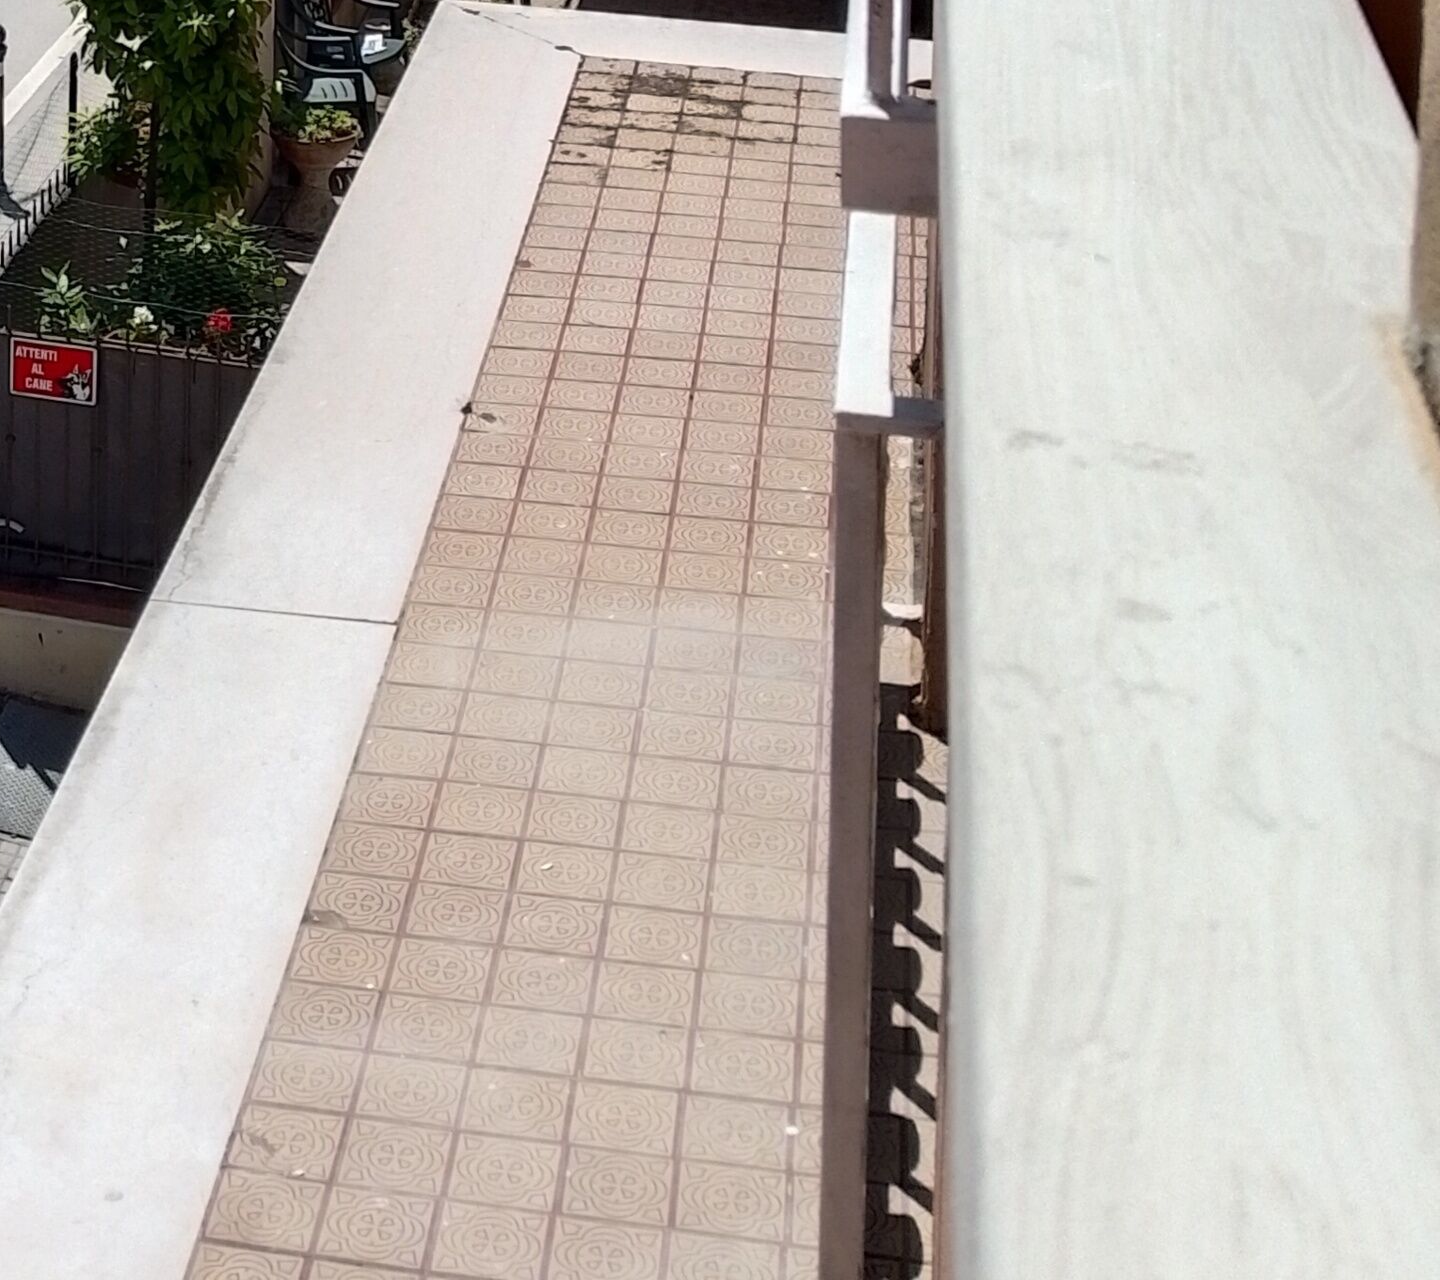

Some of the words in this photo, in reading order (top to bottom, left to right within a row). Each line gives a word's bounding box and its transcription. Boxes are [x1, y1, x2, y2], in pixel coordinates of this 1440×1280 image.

[15, 346, 58, 361] ATTENTI
[31, 363, 44, 375] AL
[25, 377, 53, 391] CANE
